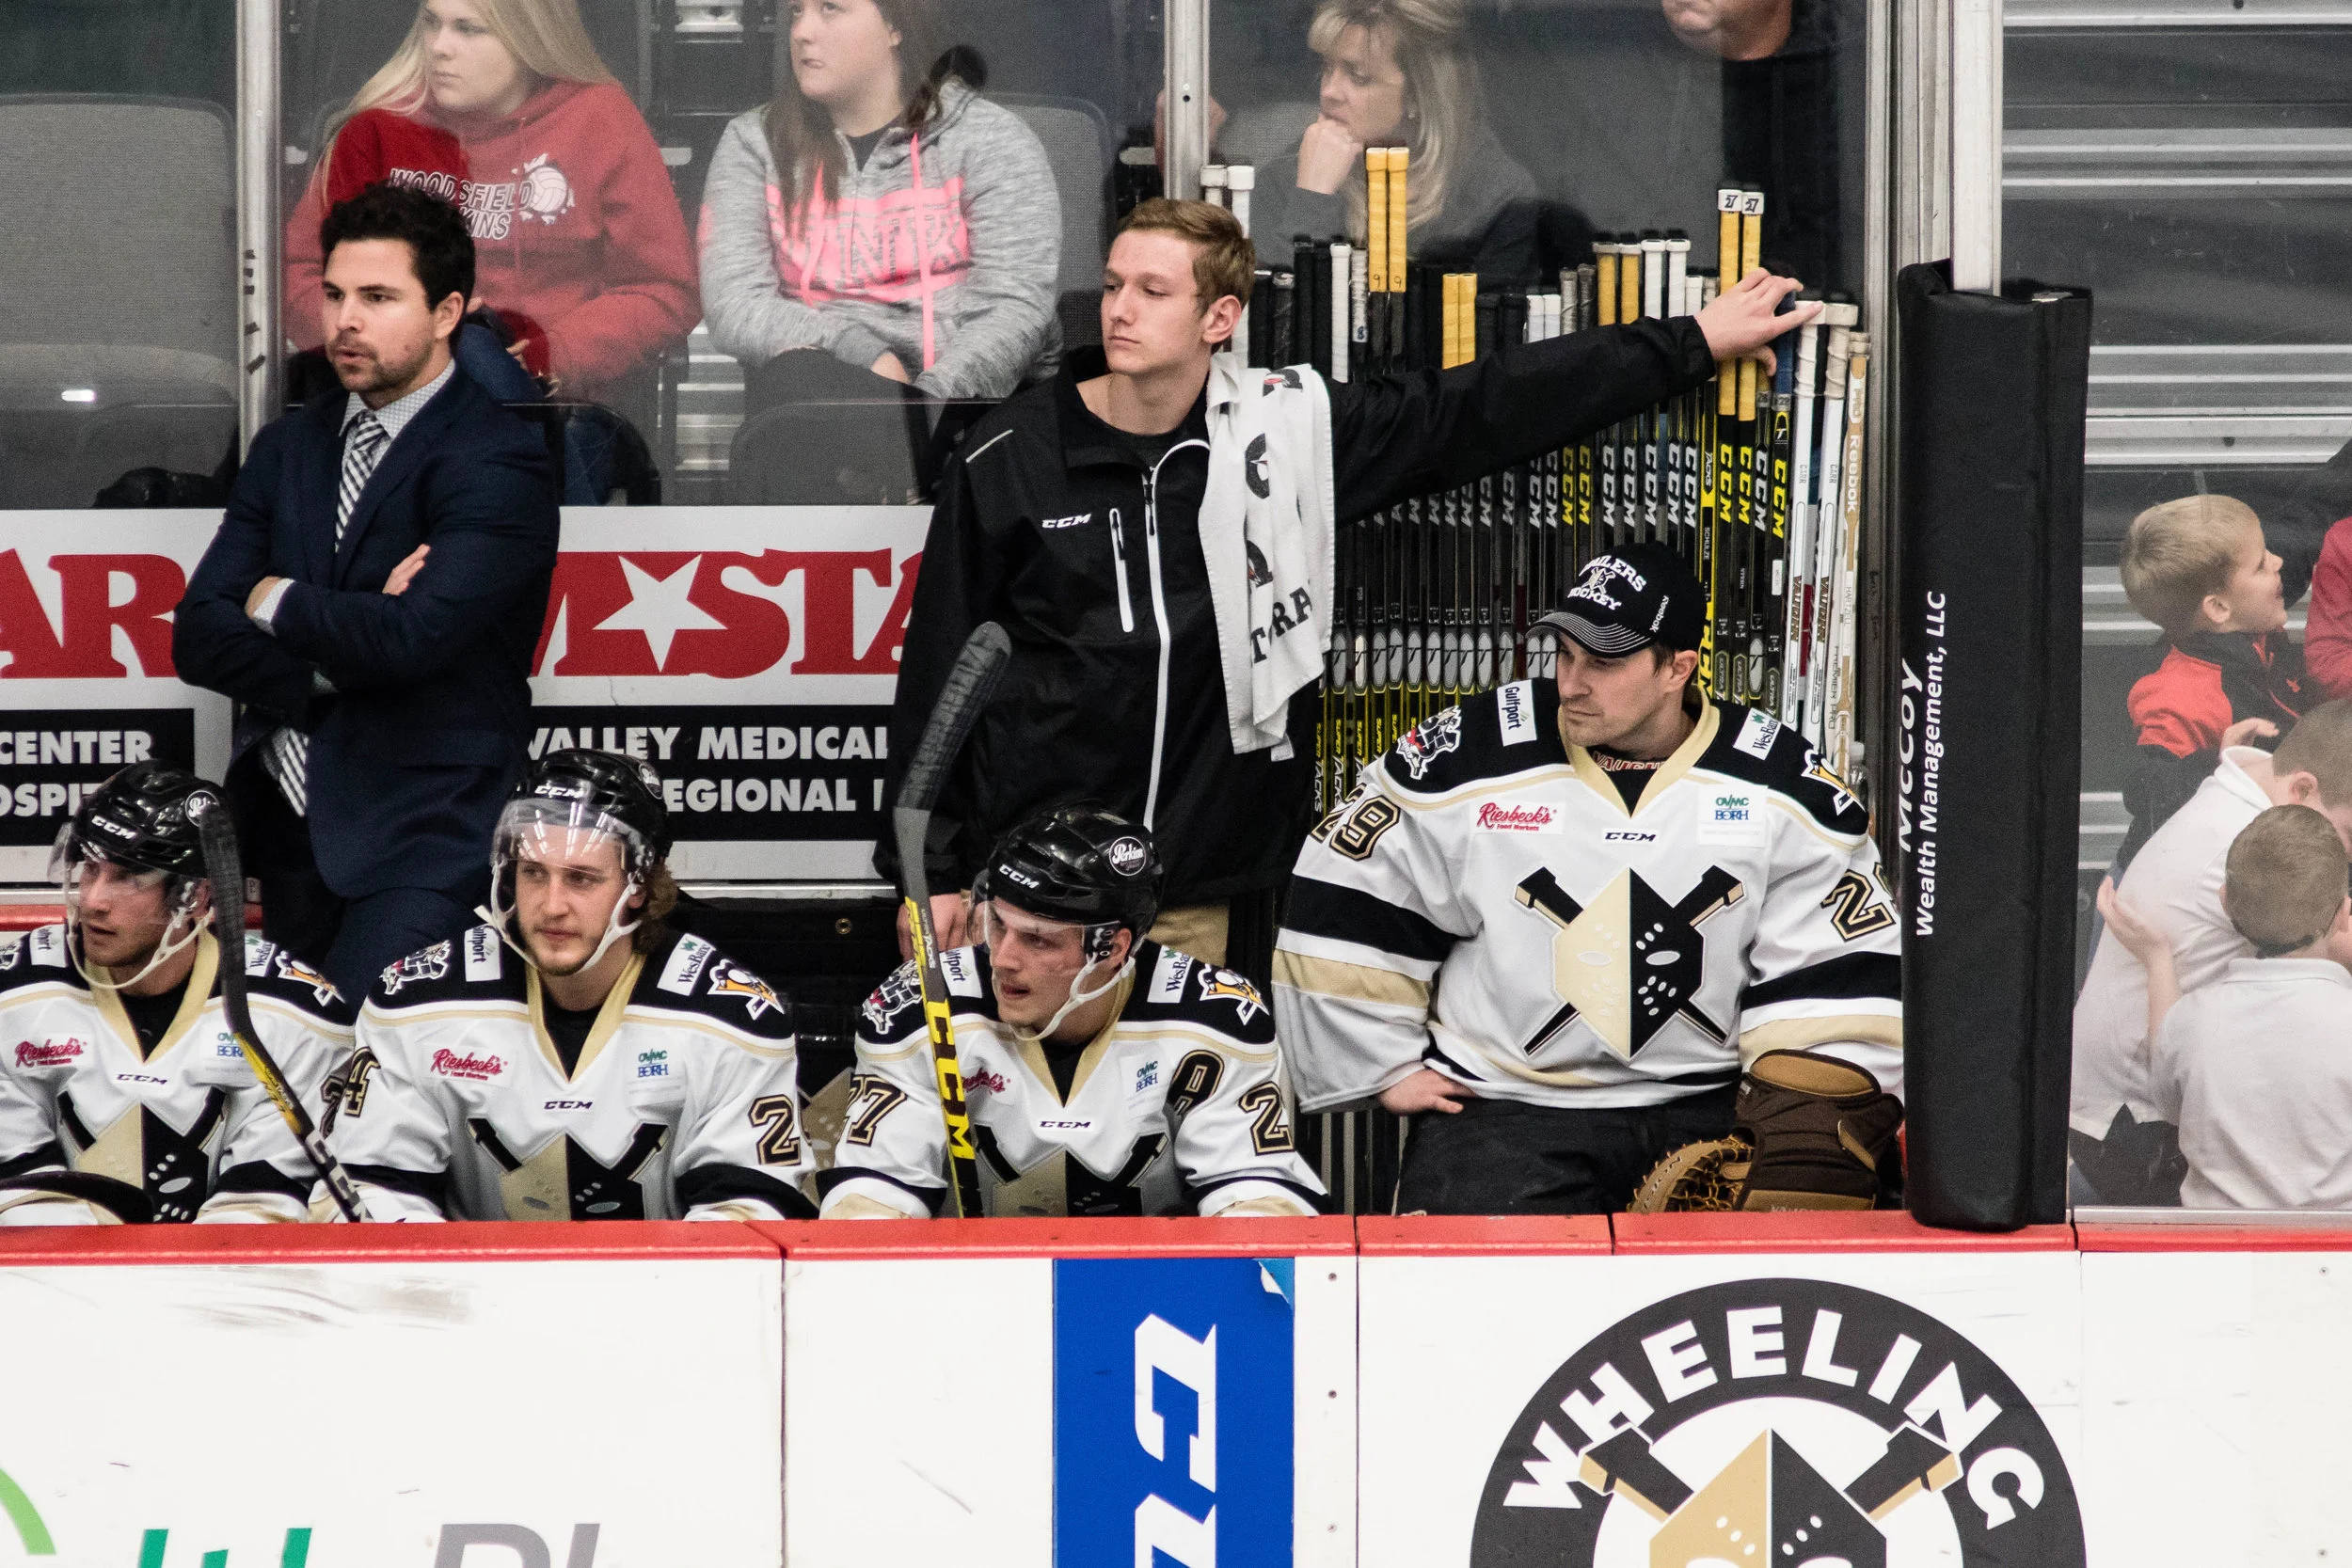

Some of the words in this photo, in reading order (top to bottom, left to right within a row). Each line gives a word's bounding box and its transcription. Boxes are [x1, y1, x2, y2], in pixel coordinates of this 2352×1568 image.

[1562, 446, 1575, 527] CCM
[1579, 444, 1591, 526] CCM
[1602, 444, 1615, 528] CCM
[1623, 445, 1636, 528] CCM
[1645, 443, 1658, 527] CCM
[1667, 442, 1680, 526] CCM
[1684, 445, 1697, 529] CCM
[1720, 443, 1733, 524] CCM
[1738, 445, 1752, 526] CCM
[1755, 450, 1768, 532] CCM
[1772, 458, 1787, 539] CCM
[1847, 435, 1861, 514] Reebok
[1041, 513, 1091, 529] CCM
[1567, 587, 1622, 610] HOCKEY
[1649, 594, 1670, 632] Reebok
[1926, 591, 1946, 639] LLC
[527, 727, 681, 761] VALLEY
[1502, 686, 1522, 731] Gulfport
[1919, 643, 1947, 833] Management,
[91, 815, 138, 840] CCM
[534, 784, 585, 799] CCM
[1477, 793, 1552, 828] Riesbeck's
[1604, 832, 1657, 843] CCM
[998, 863, 1041, 889] CCM
[1915, 840, 1937, 937] Wealth
[117, 1073, 168, 1085] CCM
[544, 1101, 594, 1110] CCM
[926, 998, 976, 1160] CCM
[1168, 1049, 1224, 1114] A
[750, 1094, 802, 1167] 2
[1040, 1120, 1091, 1129] CCM
[1239, 1082, 1294, 1156] 2
[1502, 1306, 2046, 1530] WHEELING
